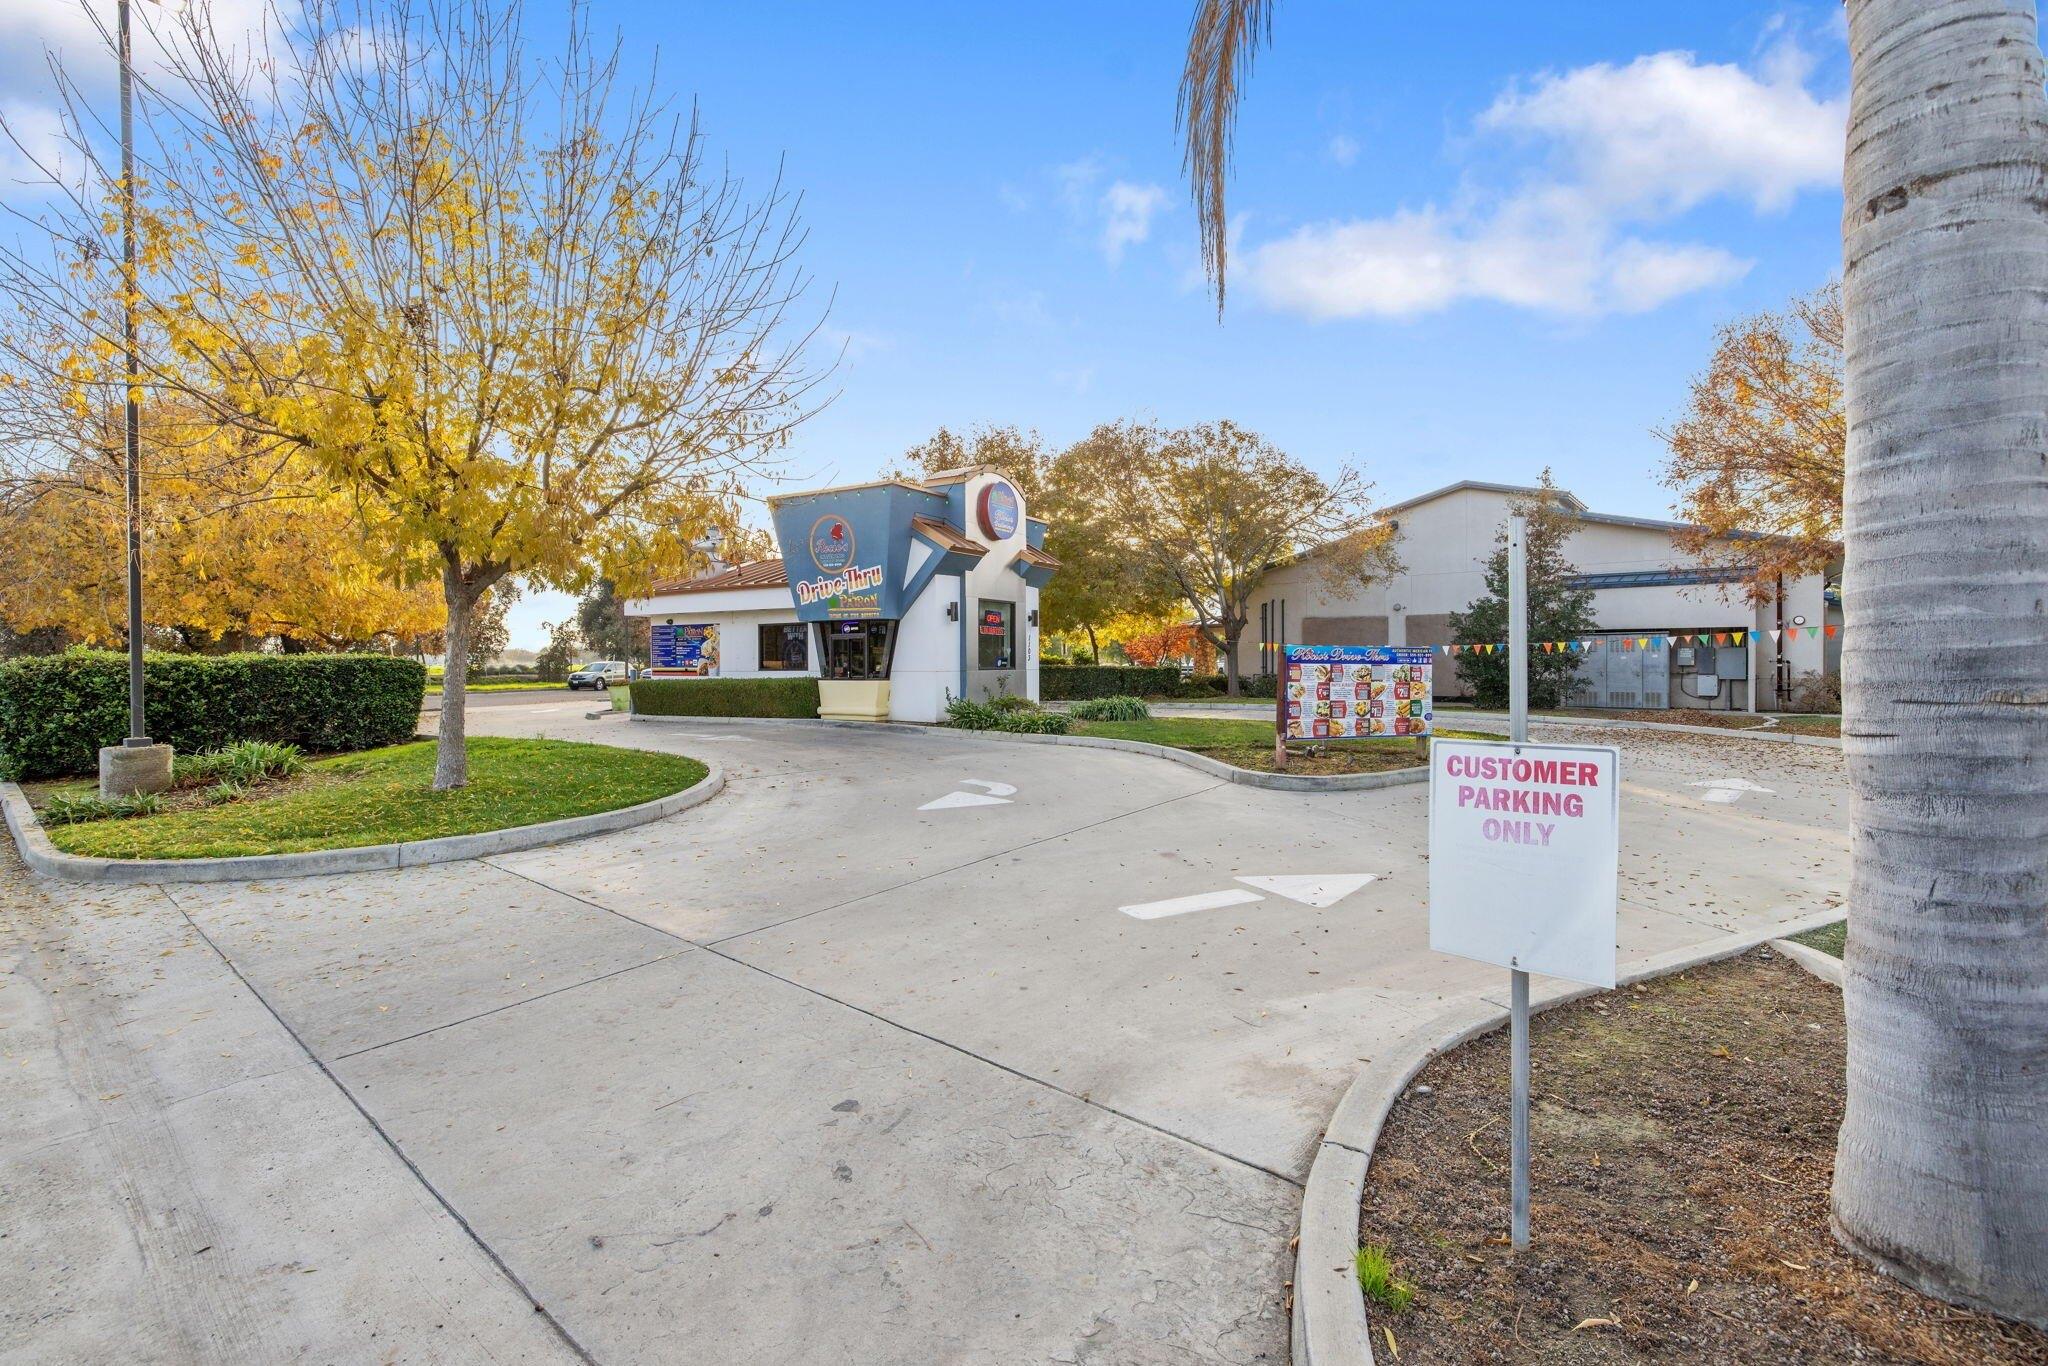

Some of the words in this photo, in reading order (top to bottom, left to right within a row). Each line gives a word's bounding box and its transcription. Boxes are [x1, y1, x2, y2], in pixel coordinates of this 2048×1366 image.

[797, 565, 883, 605] Drive-Thru
[1446, 754, 1600, 787] CUSTOMER
[1458, 785, 1585, 818] PARKING
[1482, 818, 1556, 847] ONLY
